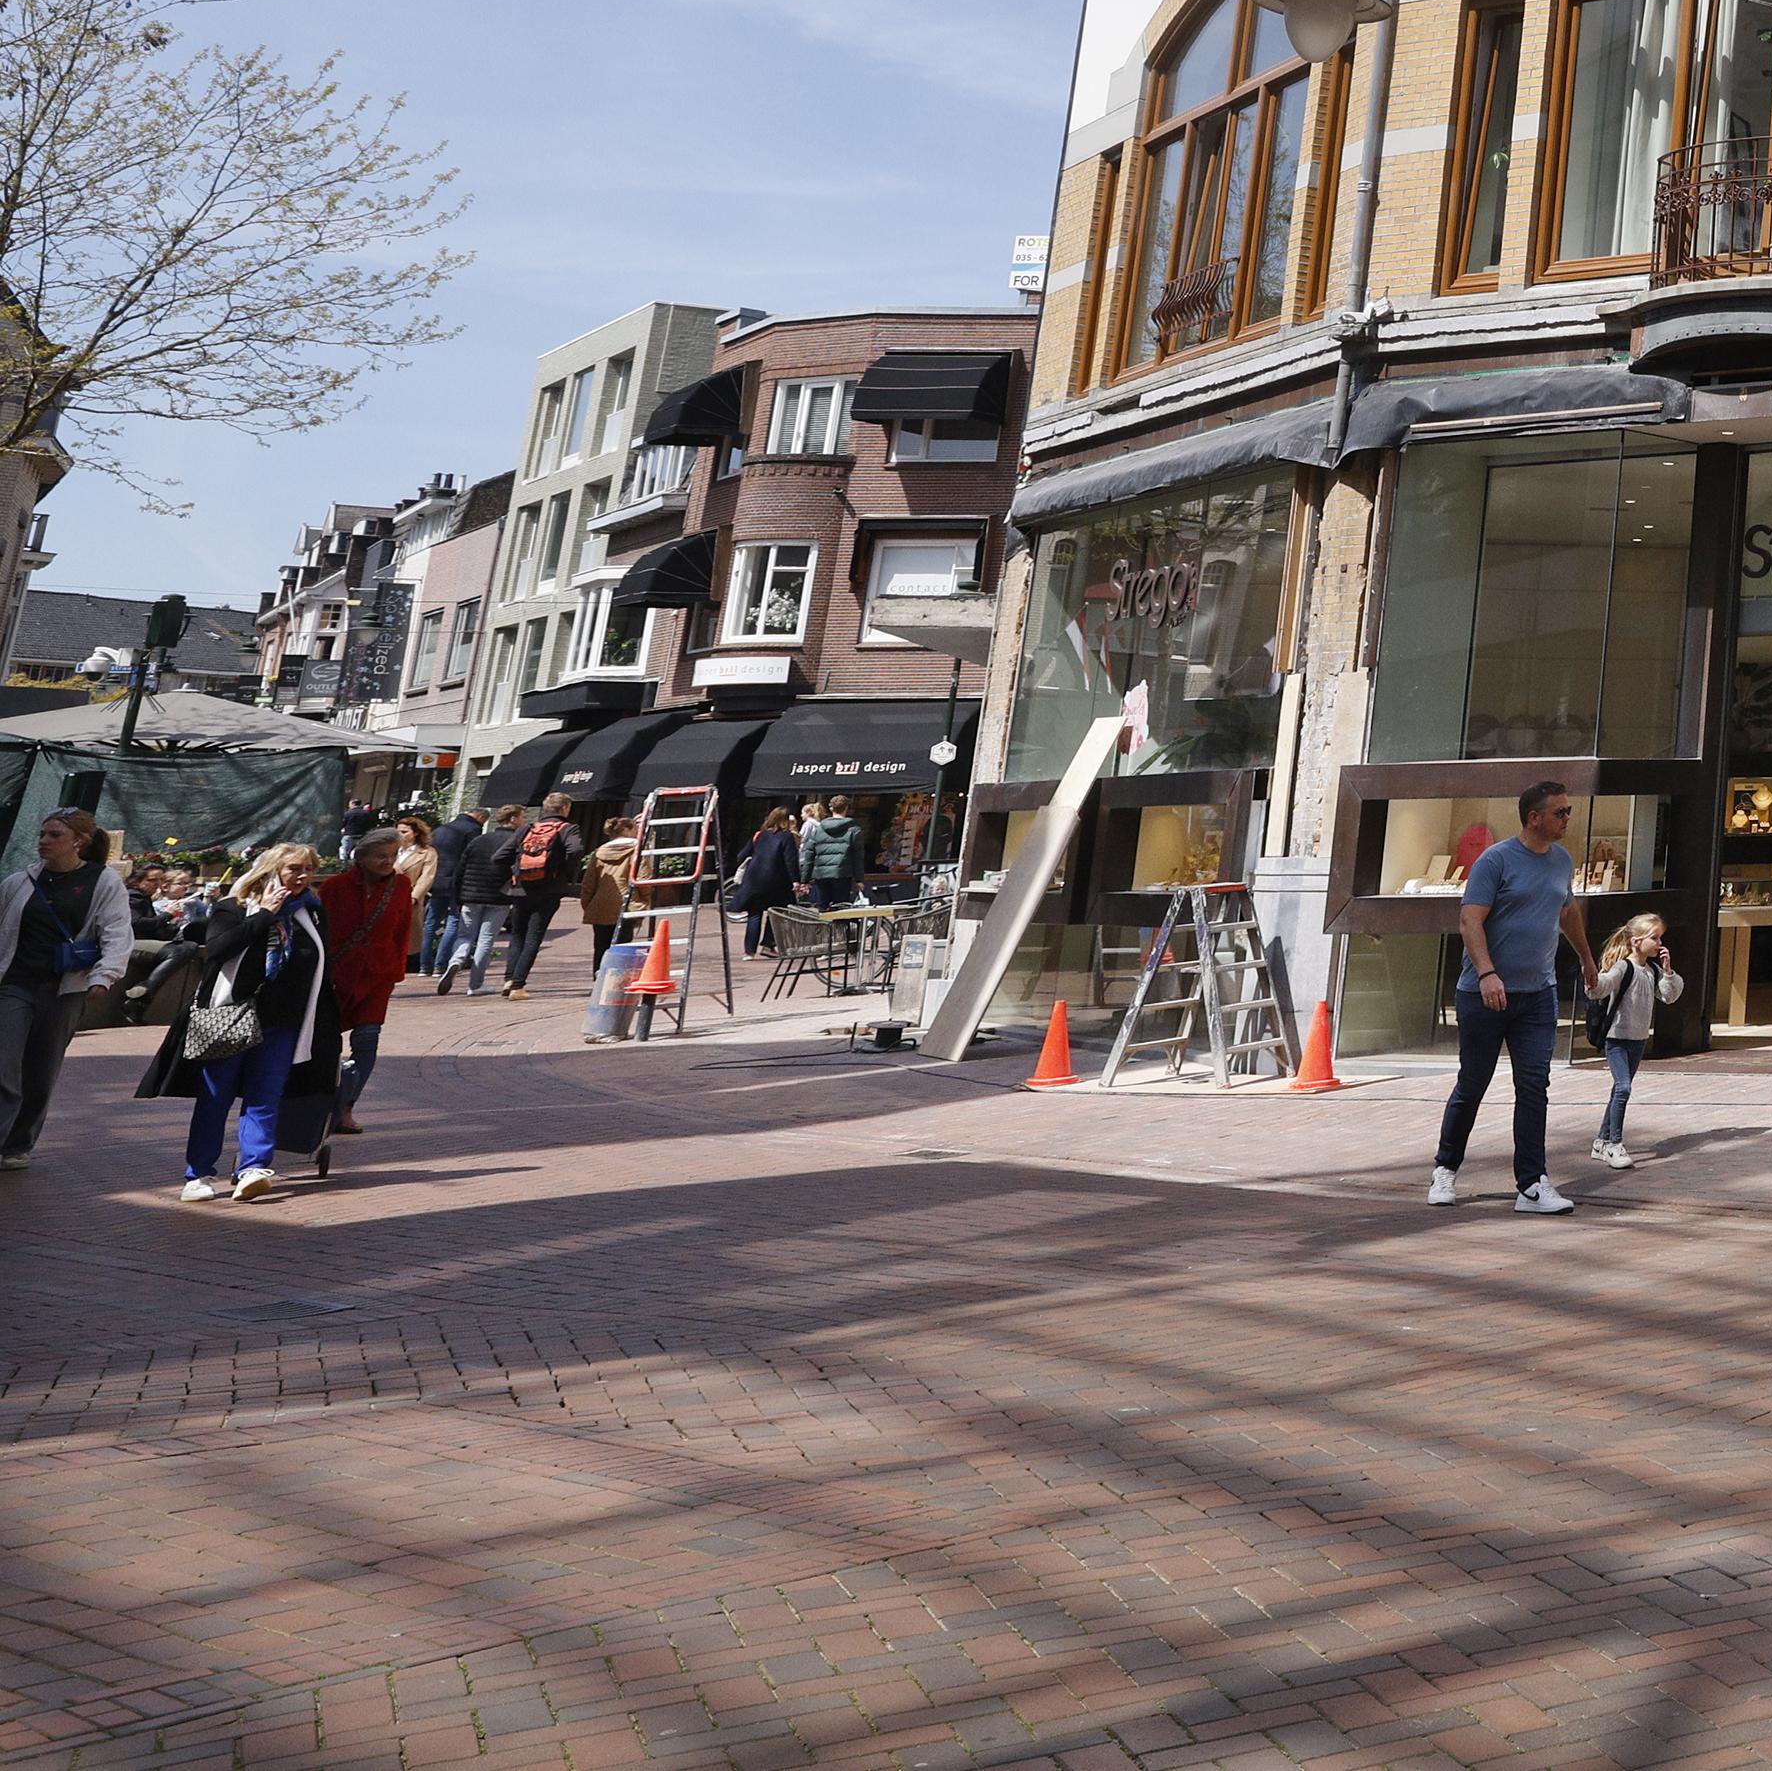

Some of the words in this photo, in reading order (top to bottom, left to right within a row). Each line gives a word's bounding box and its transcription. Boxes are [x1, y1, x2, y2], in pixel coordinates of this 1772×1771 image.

[1013, 275, 1039, 286] FOR
[890, 584, 948, 593] contact
[1107, 559, 1189, 628] Strego
[790, 763, 832, 775] jasper
[835, 762, 860, 774] bril
[864, 761, 906, 773] design
